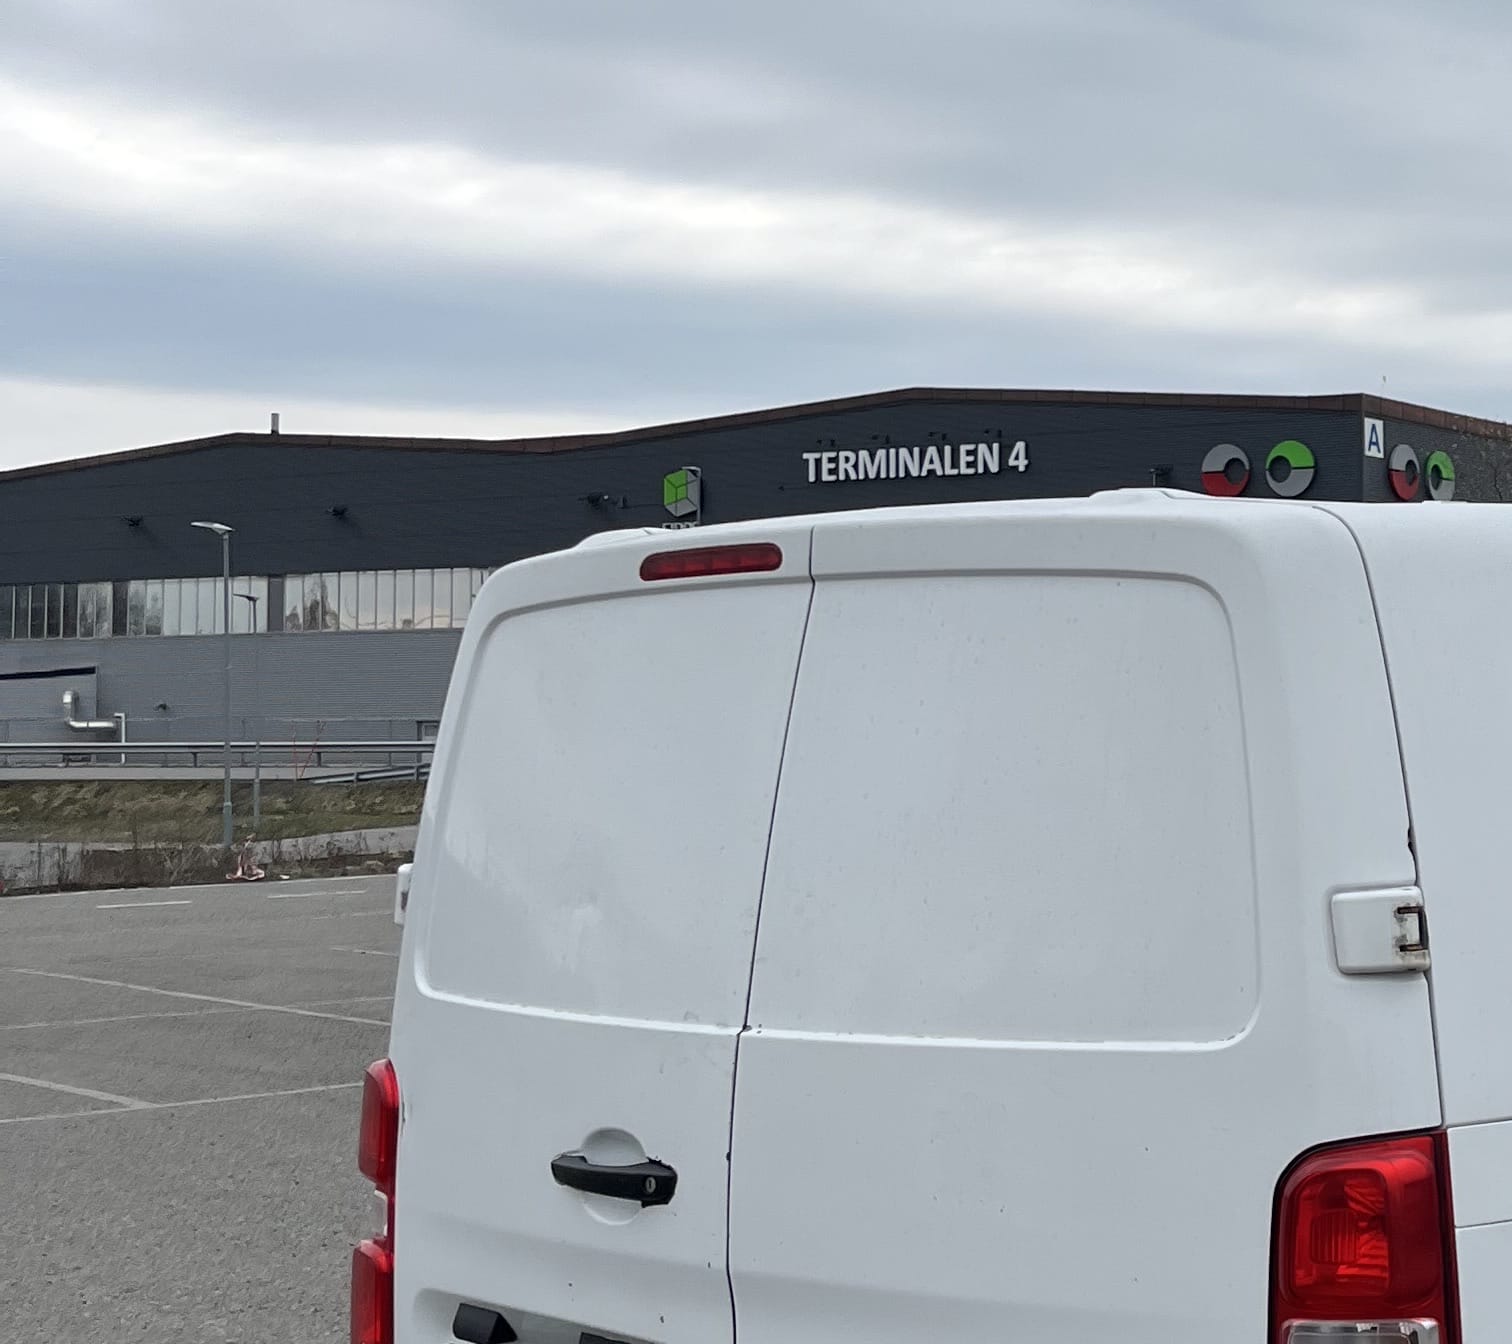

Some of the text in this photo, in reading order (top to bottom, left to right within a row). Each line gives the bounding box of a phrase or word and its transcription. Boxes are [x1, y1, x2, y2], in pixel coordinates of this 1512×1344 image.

[1368, 424, 1381, 454] A
[802, 440, 1029, 483] TERMINALEN 4
